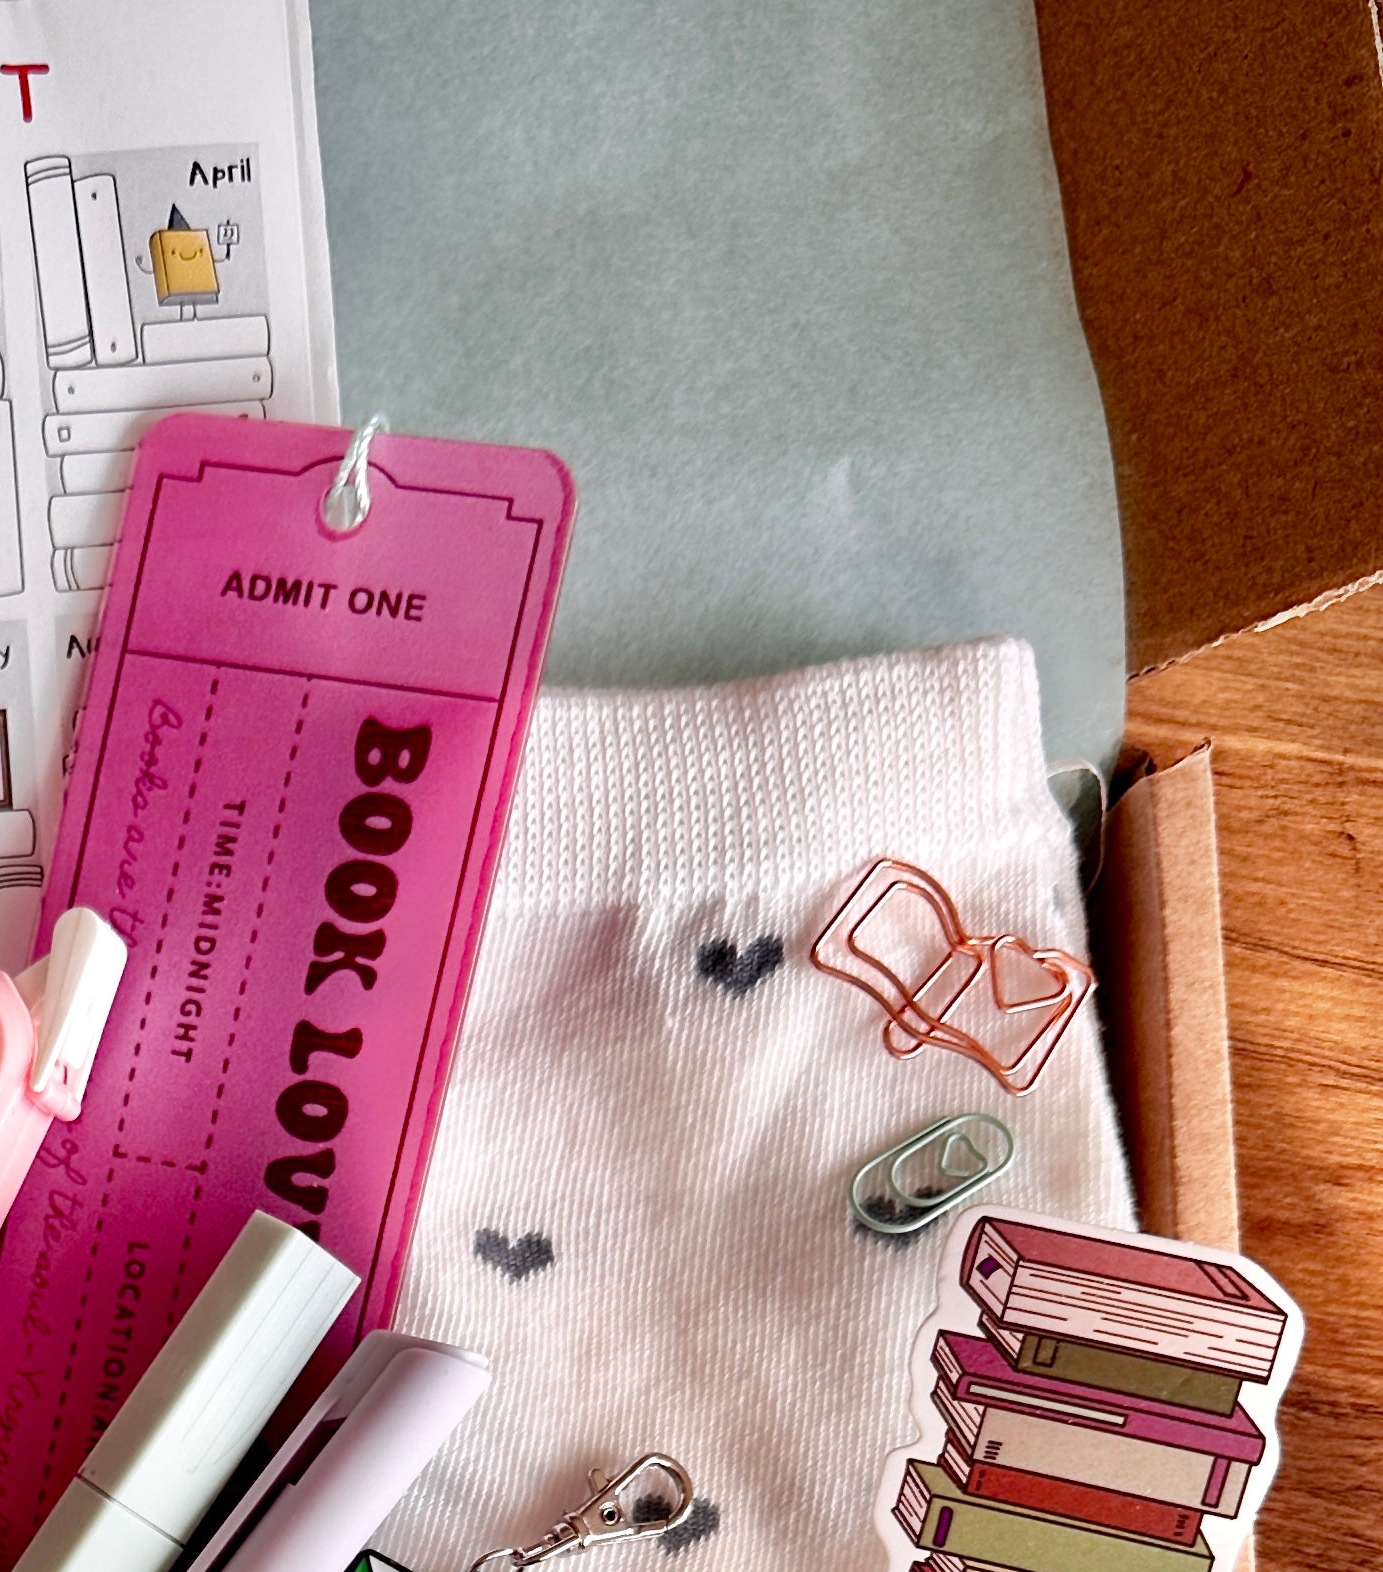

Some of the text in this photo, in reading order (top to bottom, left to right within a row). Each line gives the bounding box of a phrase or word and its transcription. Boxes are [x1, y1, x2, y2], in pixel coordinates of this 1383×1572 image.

[189, 158, 252, 188] April
[220, 570, 427, 622] ADMIT ONE
[66, 634, 101, 659] Au
[131, 698, 183, 818] Books
[117, 823, 145, 899] are
[263, 715, 432, 1241] BOOK LOV
[42, 1189, 84, 1252] the
